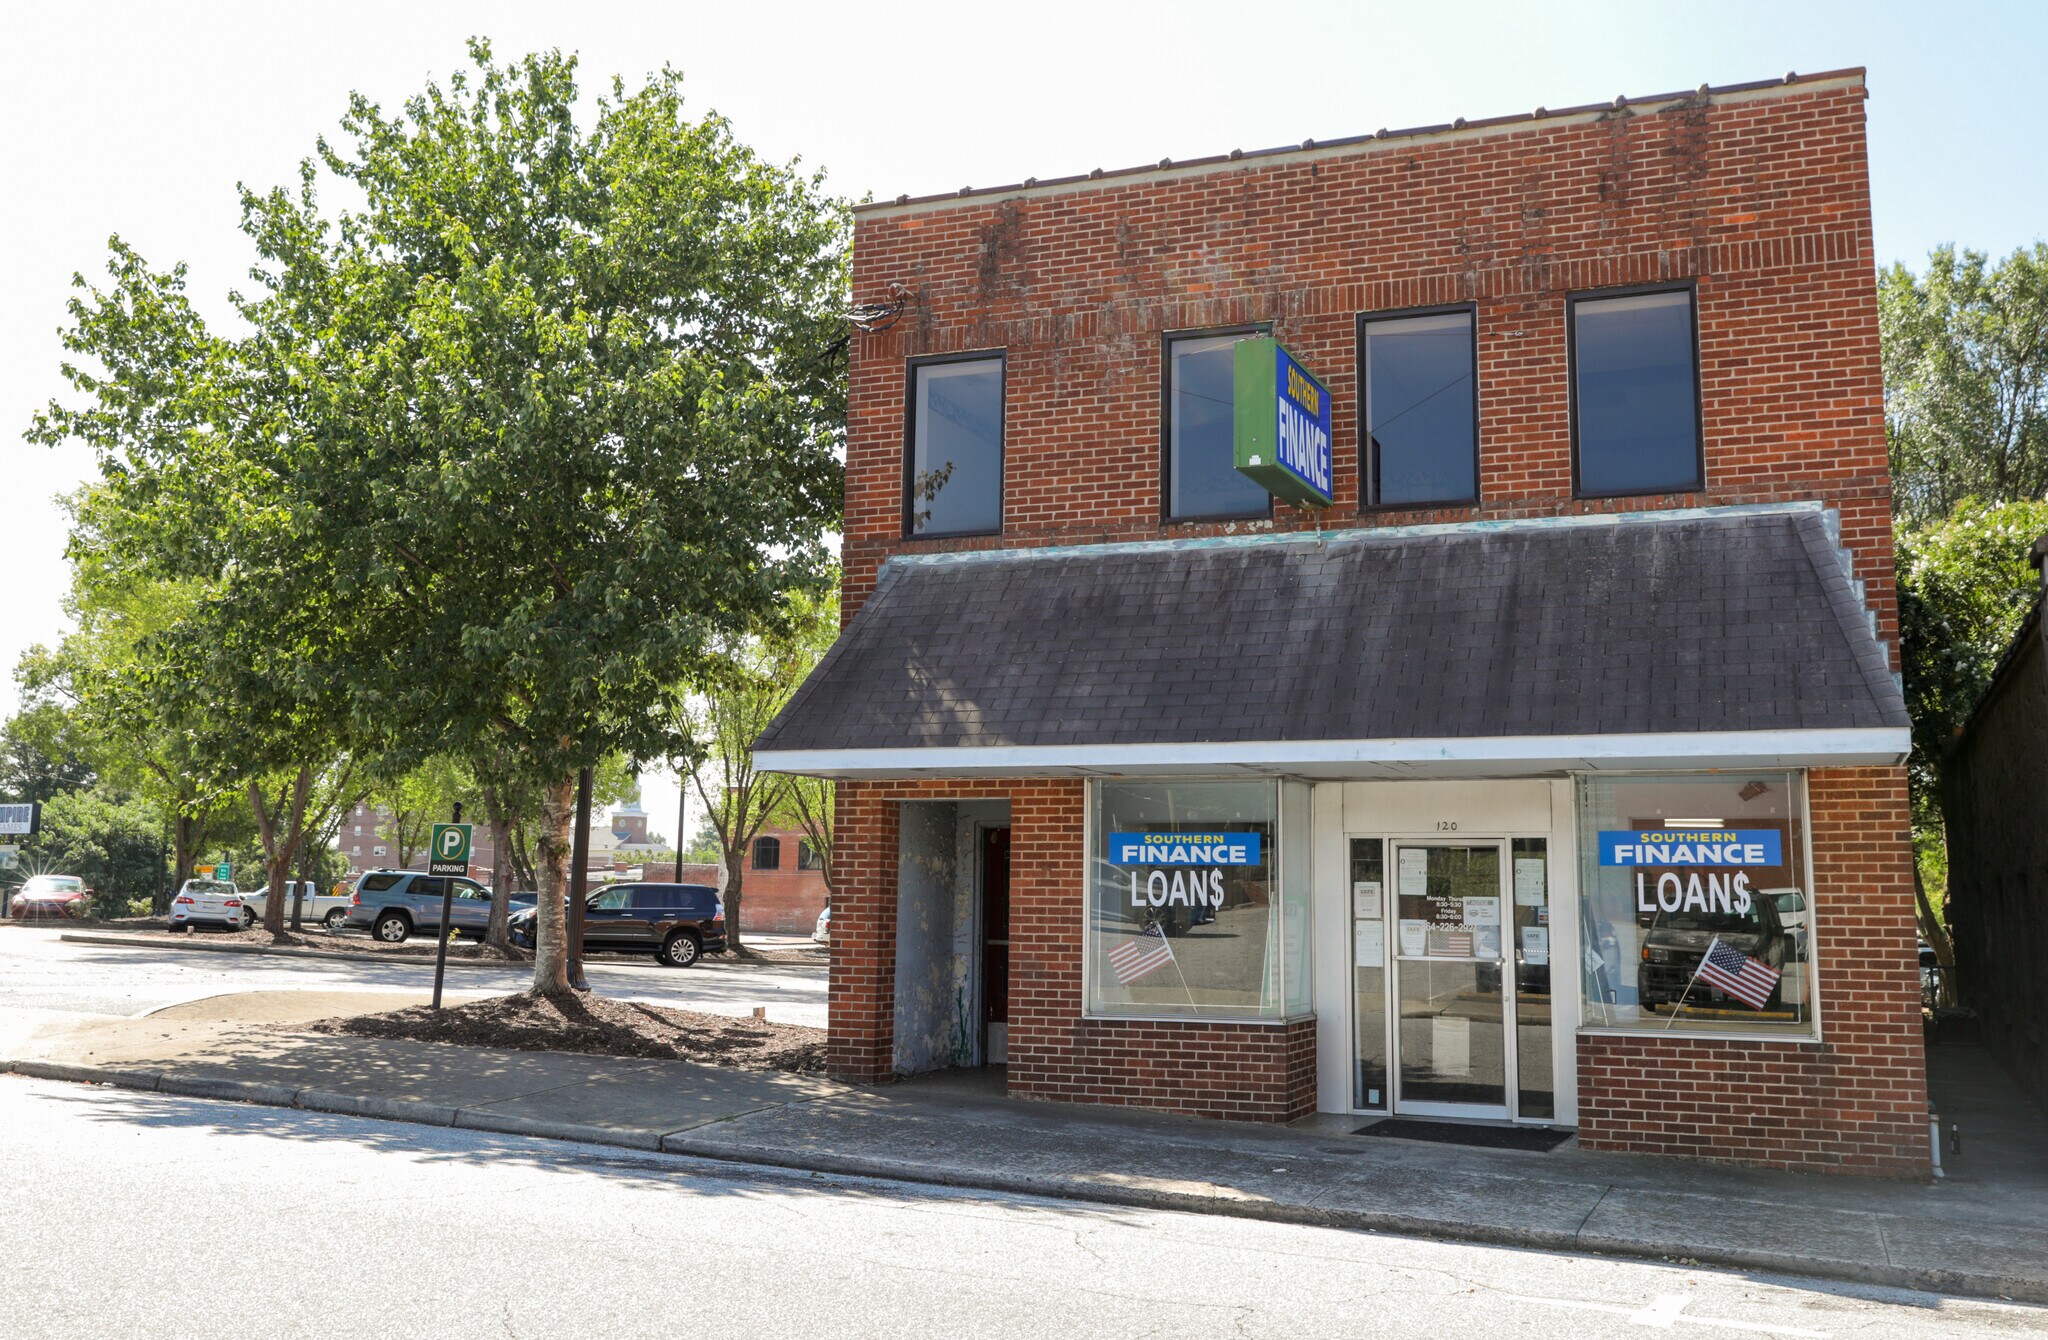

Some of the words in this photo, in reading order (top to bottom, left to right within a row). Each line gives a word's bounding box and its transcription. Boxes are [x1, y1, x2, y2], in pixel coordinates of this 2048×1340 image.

[1288, 365, 1319, 418] SOUTHERN
[1279, 396, 1328, 492] FINANCE
[1436, 821, 1458, 831] 120
[443, 831, 460, 855] P
[1144, 834, 1225, 844] SOUTHERN
[1640, 832, 1737, 843] SOUTHERN
[1122, 845, 1247, 863] FINANCE
[1614, 844, 1765, 864] FINANCE
[432, 864, 465, 873] PARKING
[1131, 867, 1225, 911] LOAN$
[1637, 870, 1751, 919] LOAN$
